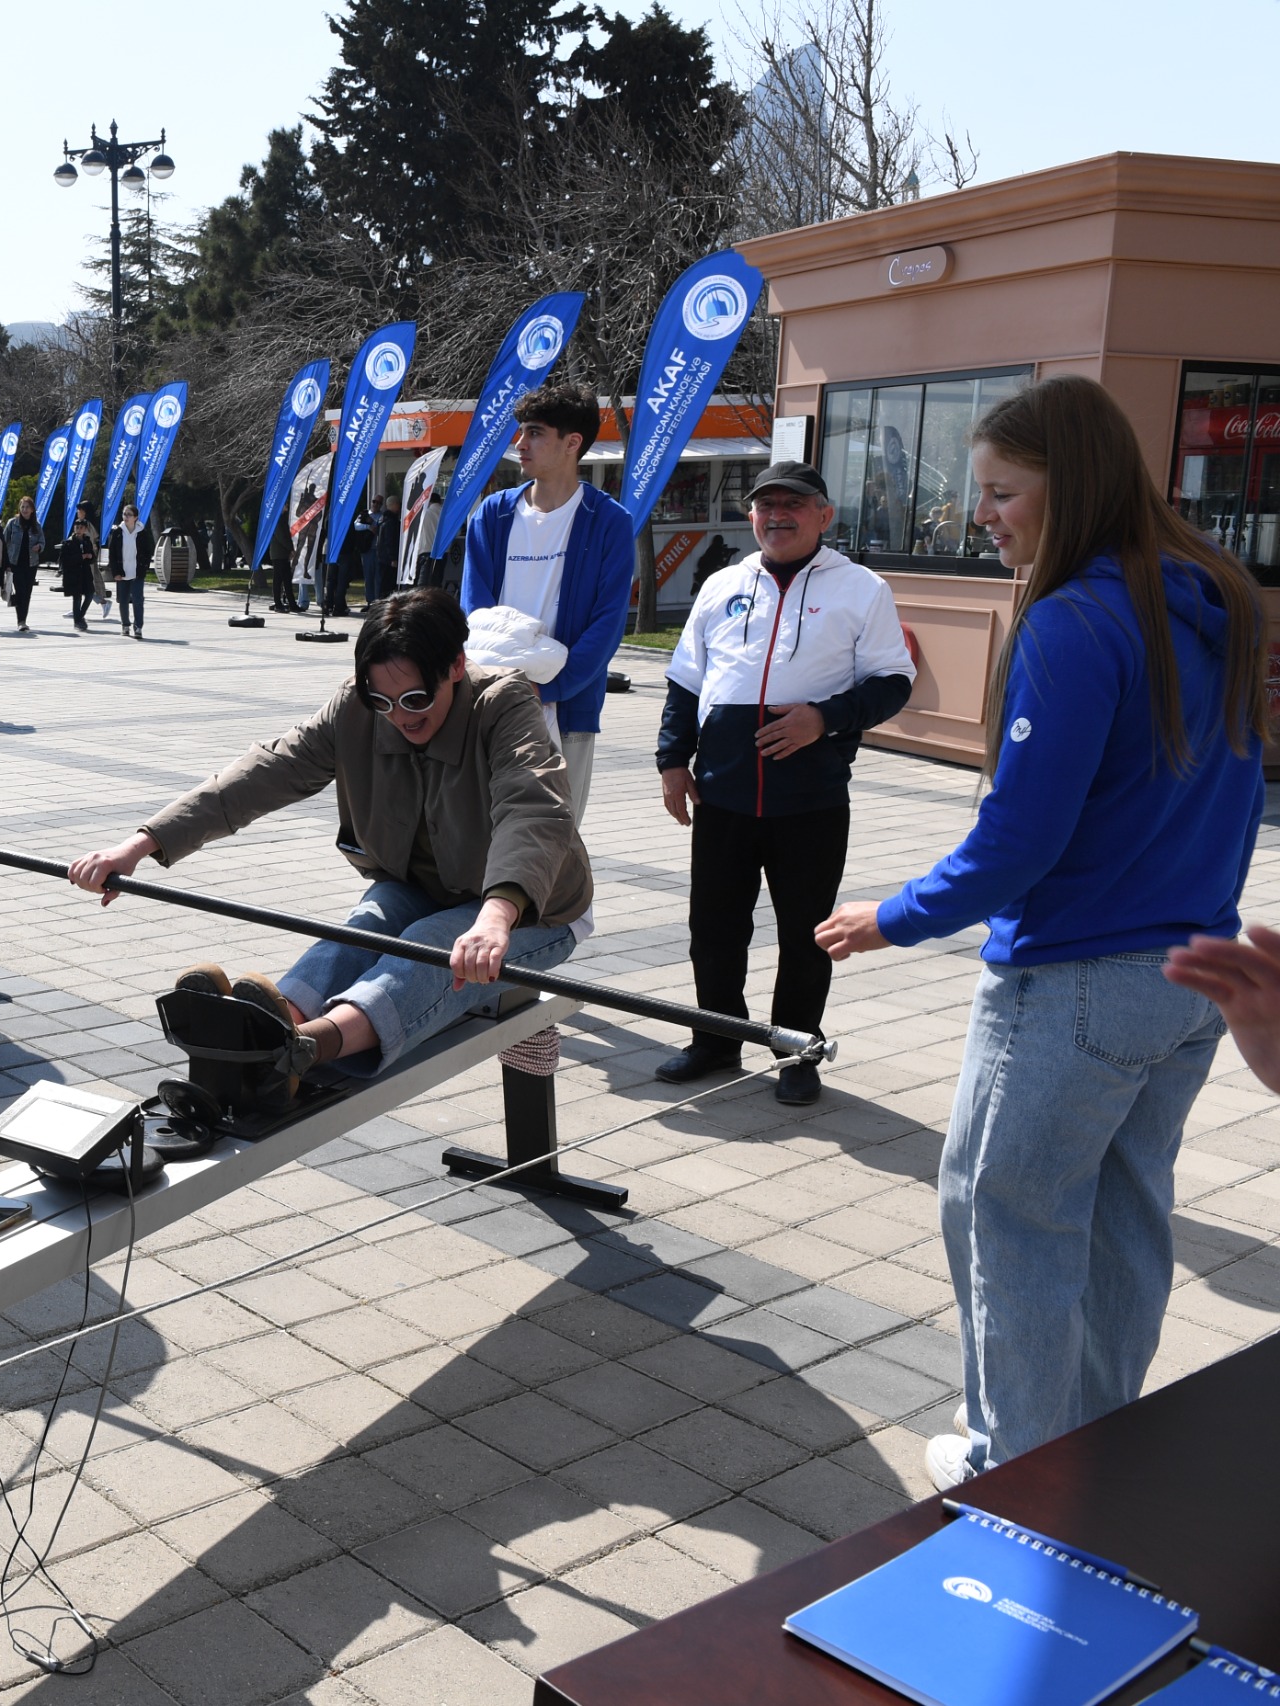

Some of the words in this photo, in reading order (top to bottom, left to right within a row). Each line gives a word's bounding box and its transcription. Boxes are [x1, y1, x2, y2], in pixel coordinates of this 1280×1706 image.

[480, 375, 514, 429] AKAF
[646, 347, 687, 415] AKAF
[346, 395, 370, 443] AKAF
[359, 415, 374, 442] KANOE
[631, 411, 670, 481] AZƏRBAYCAN
[667, 373, 694, 412] KANOE
[688, 356, 702, 373] VƏ
[70, 443, 82, 473] AKAF
[113, 438, 127, 469] AKAF
[142, 432, 158, 465] AKAF
[275, 425, 296, 467] AKAF
[40, 464, 54, 490] AKAF
[632, 437, 671, 500] AVARÇƏKMƏ
